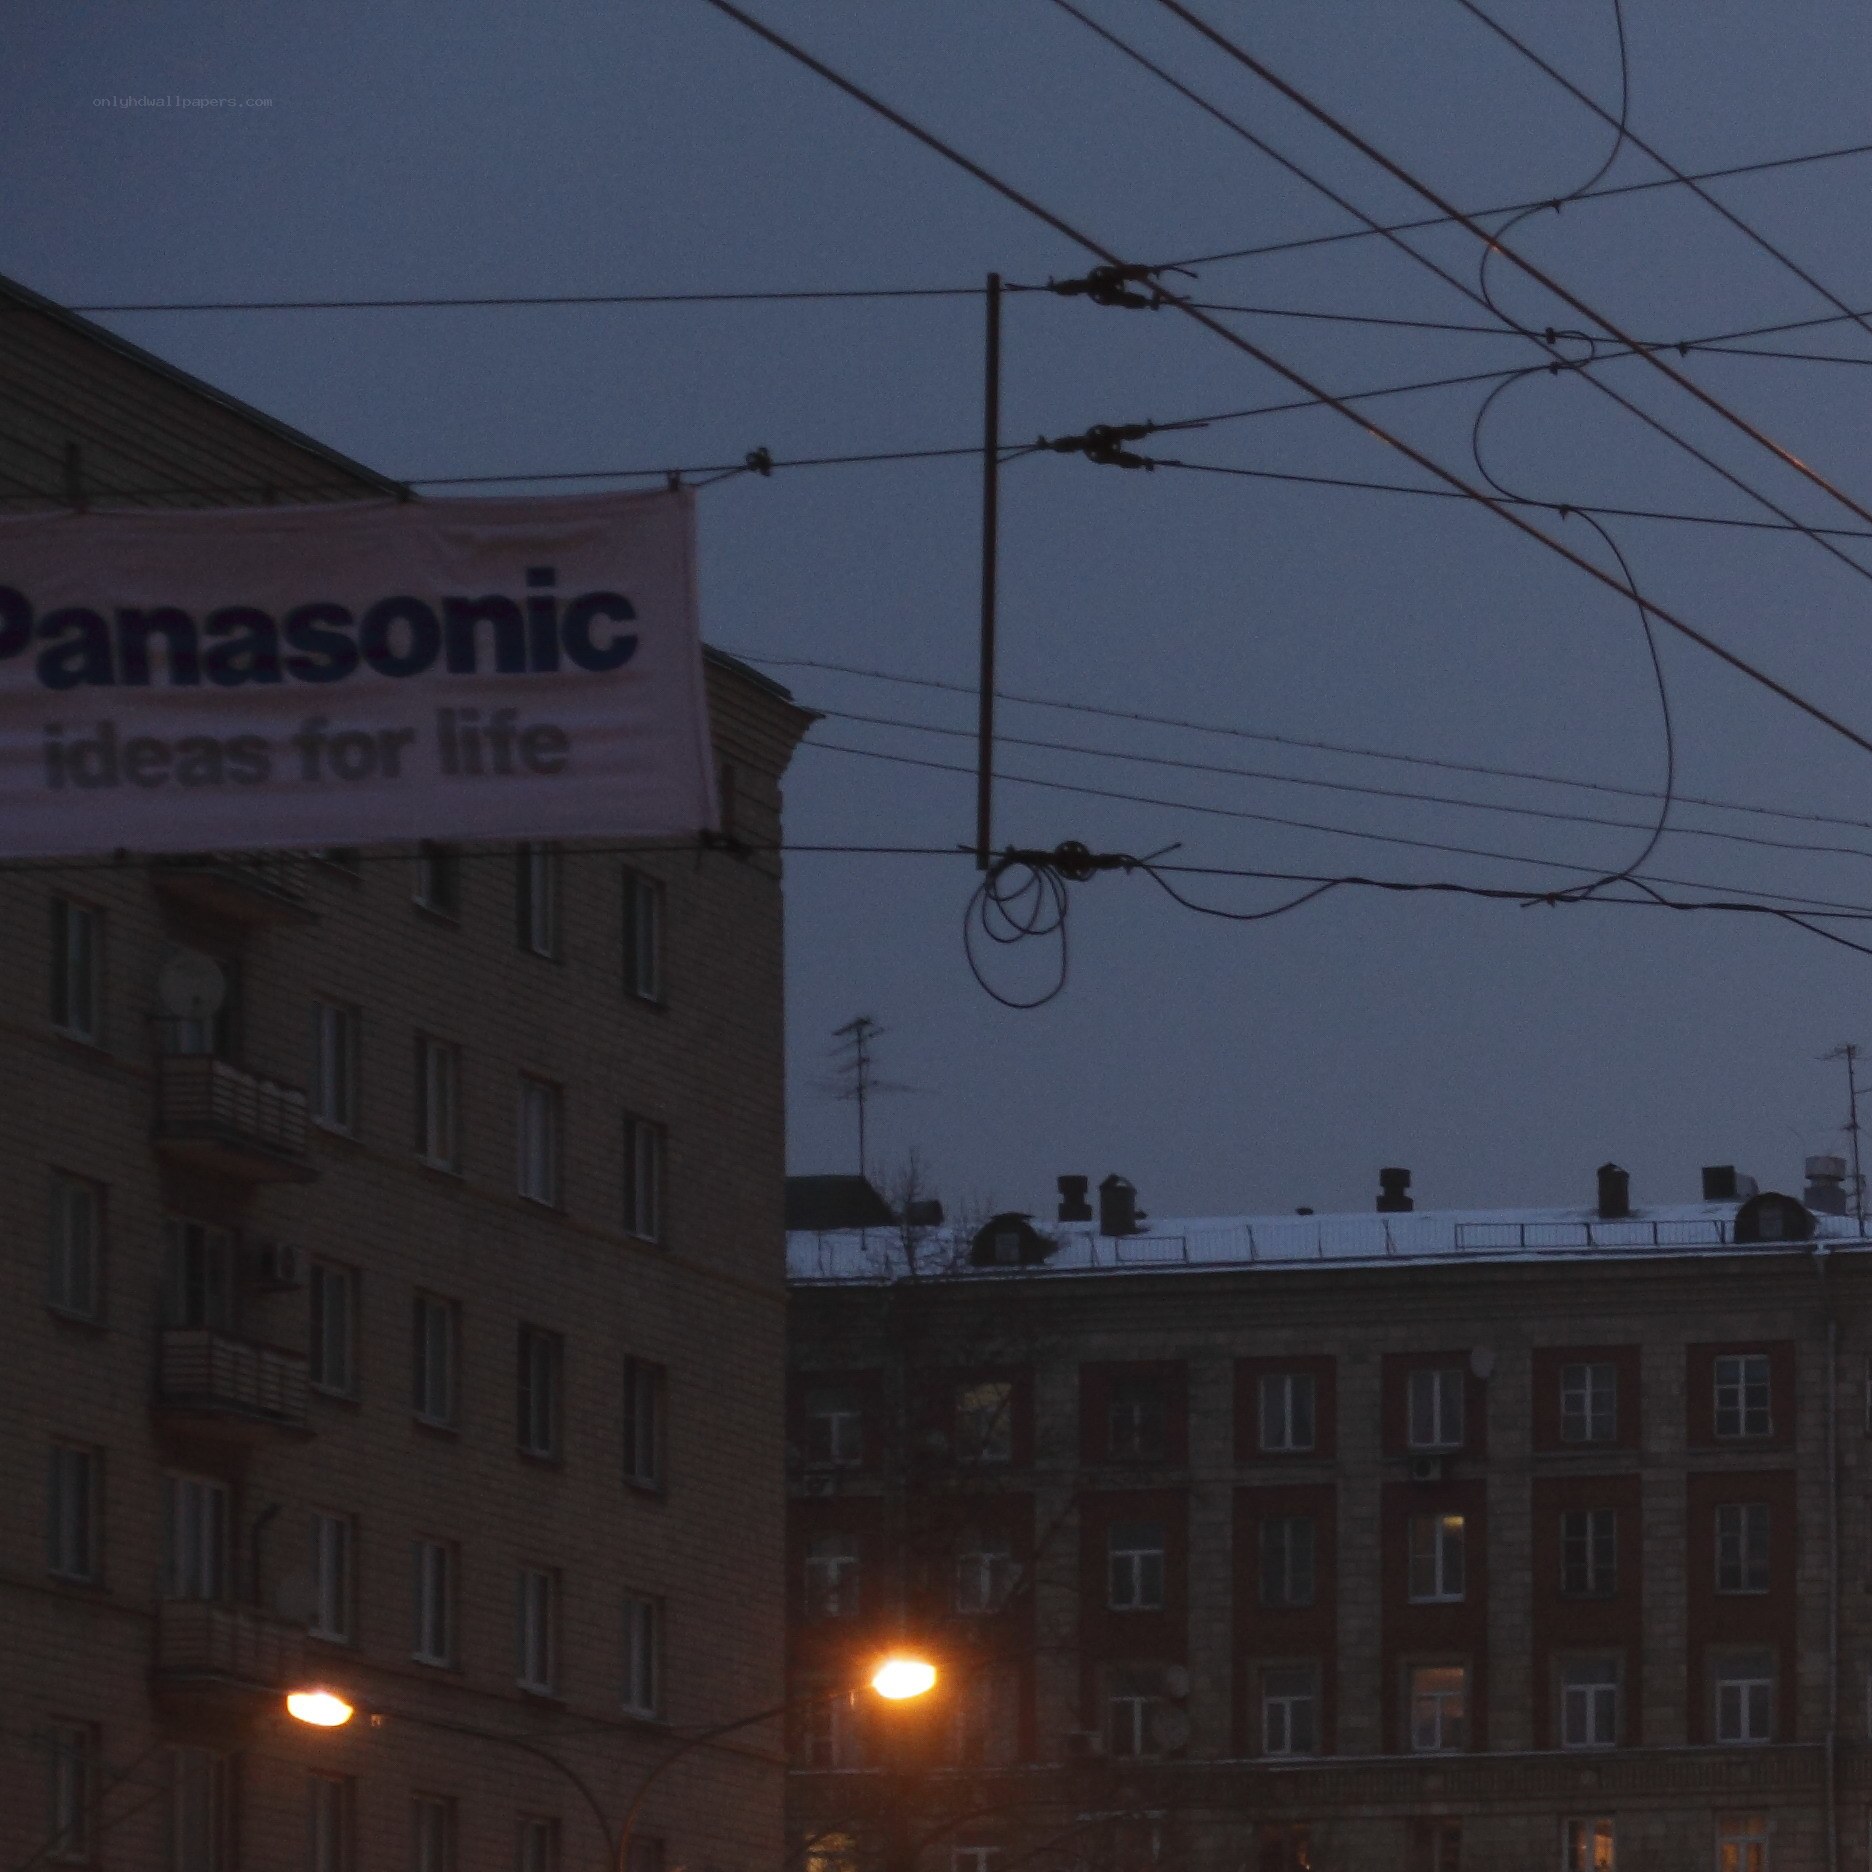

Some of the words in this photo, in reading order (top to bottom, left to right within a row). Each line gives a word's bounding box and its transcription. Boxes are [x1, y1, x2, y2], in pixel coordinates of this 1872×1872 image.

[44, 719, 271, 789] ideas
[292, 715, 415, 783] for
[436, 707, 571, 777] life
